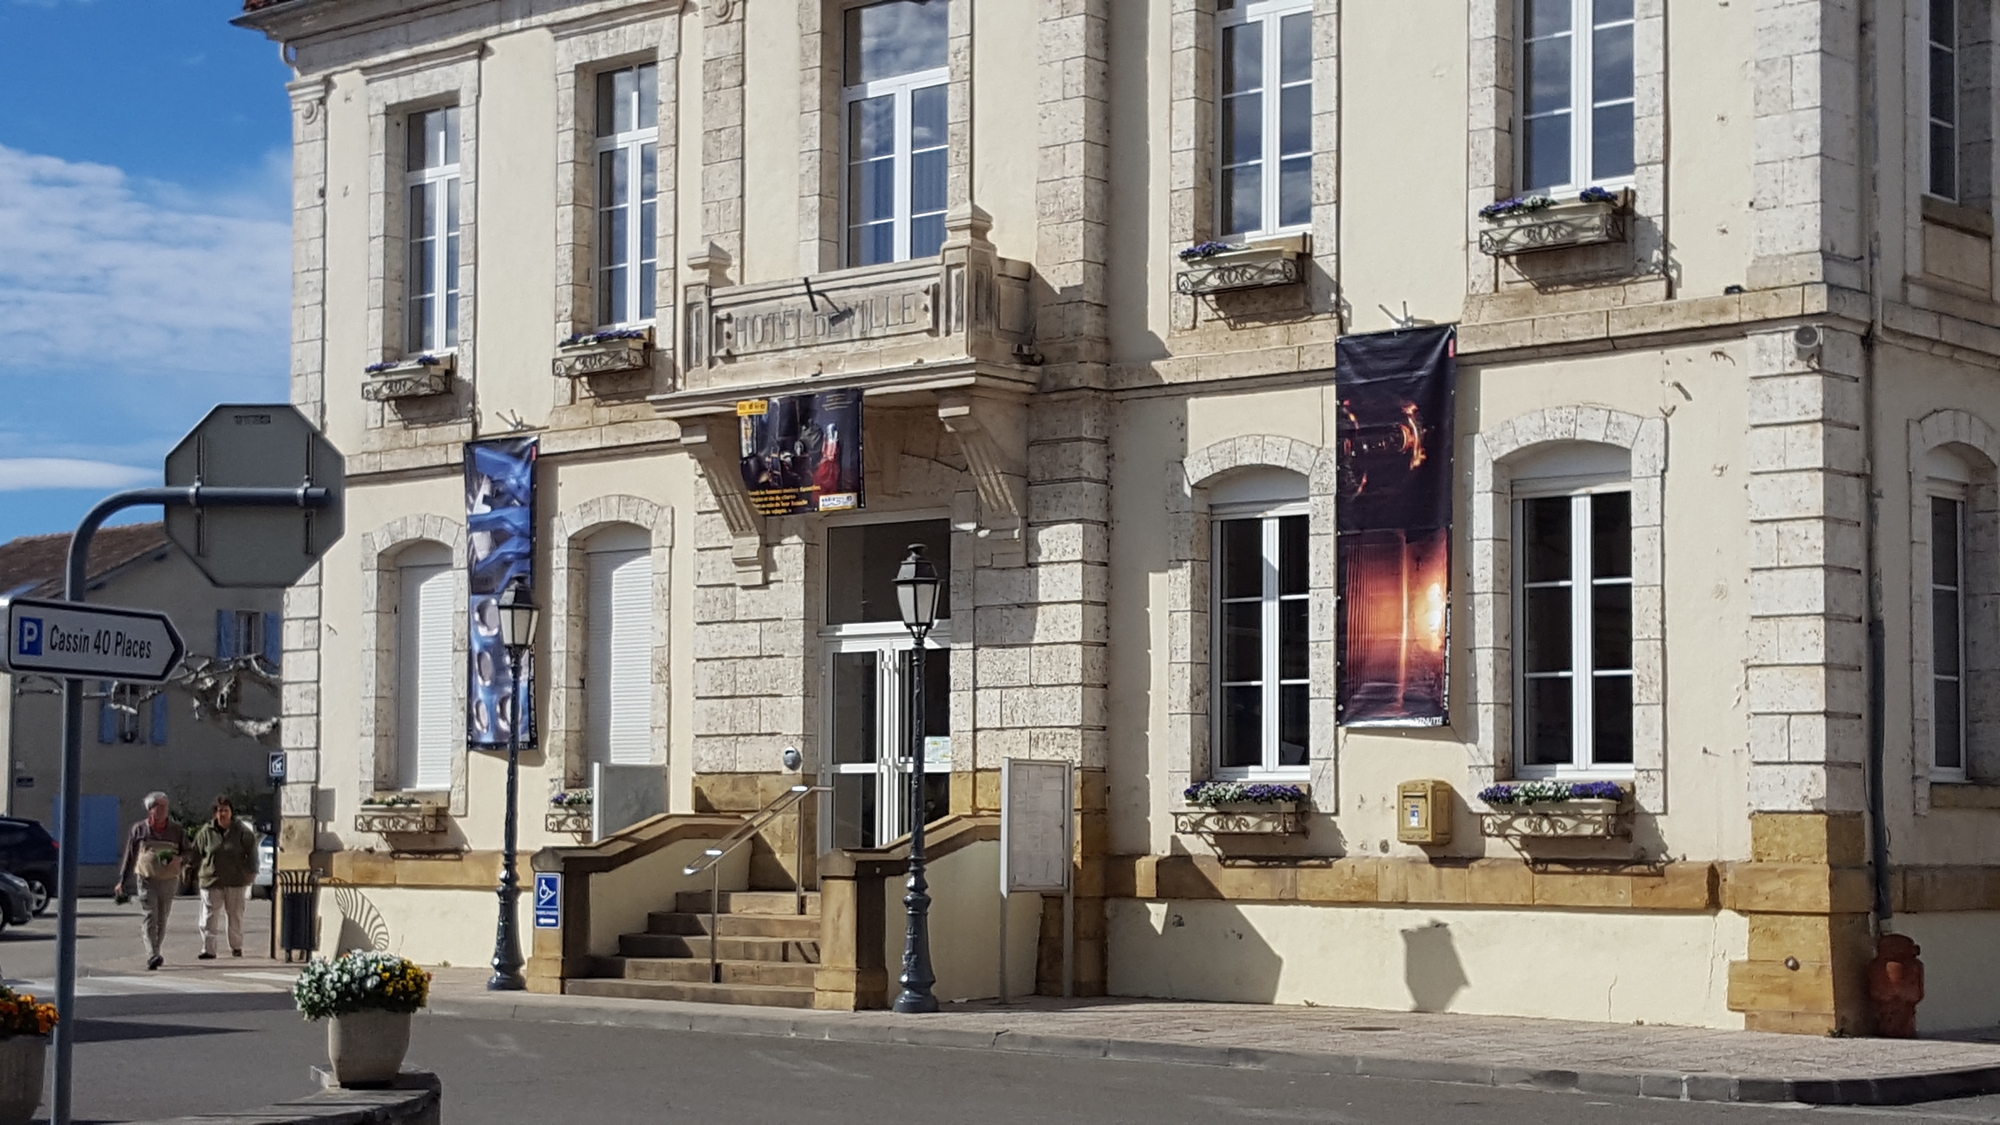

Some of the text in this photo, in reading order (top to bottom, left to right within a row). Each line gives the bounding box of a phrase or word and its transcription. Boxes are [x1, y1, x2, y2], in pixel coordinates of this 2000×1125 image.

[842, 293, 916, 338] VILLE
[50, 625, 90, 653] Cassin
[93, 629, 111, 656] 40
[115, 631, 152, 659] Places
